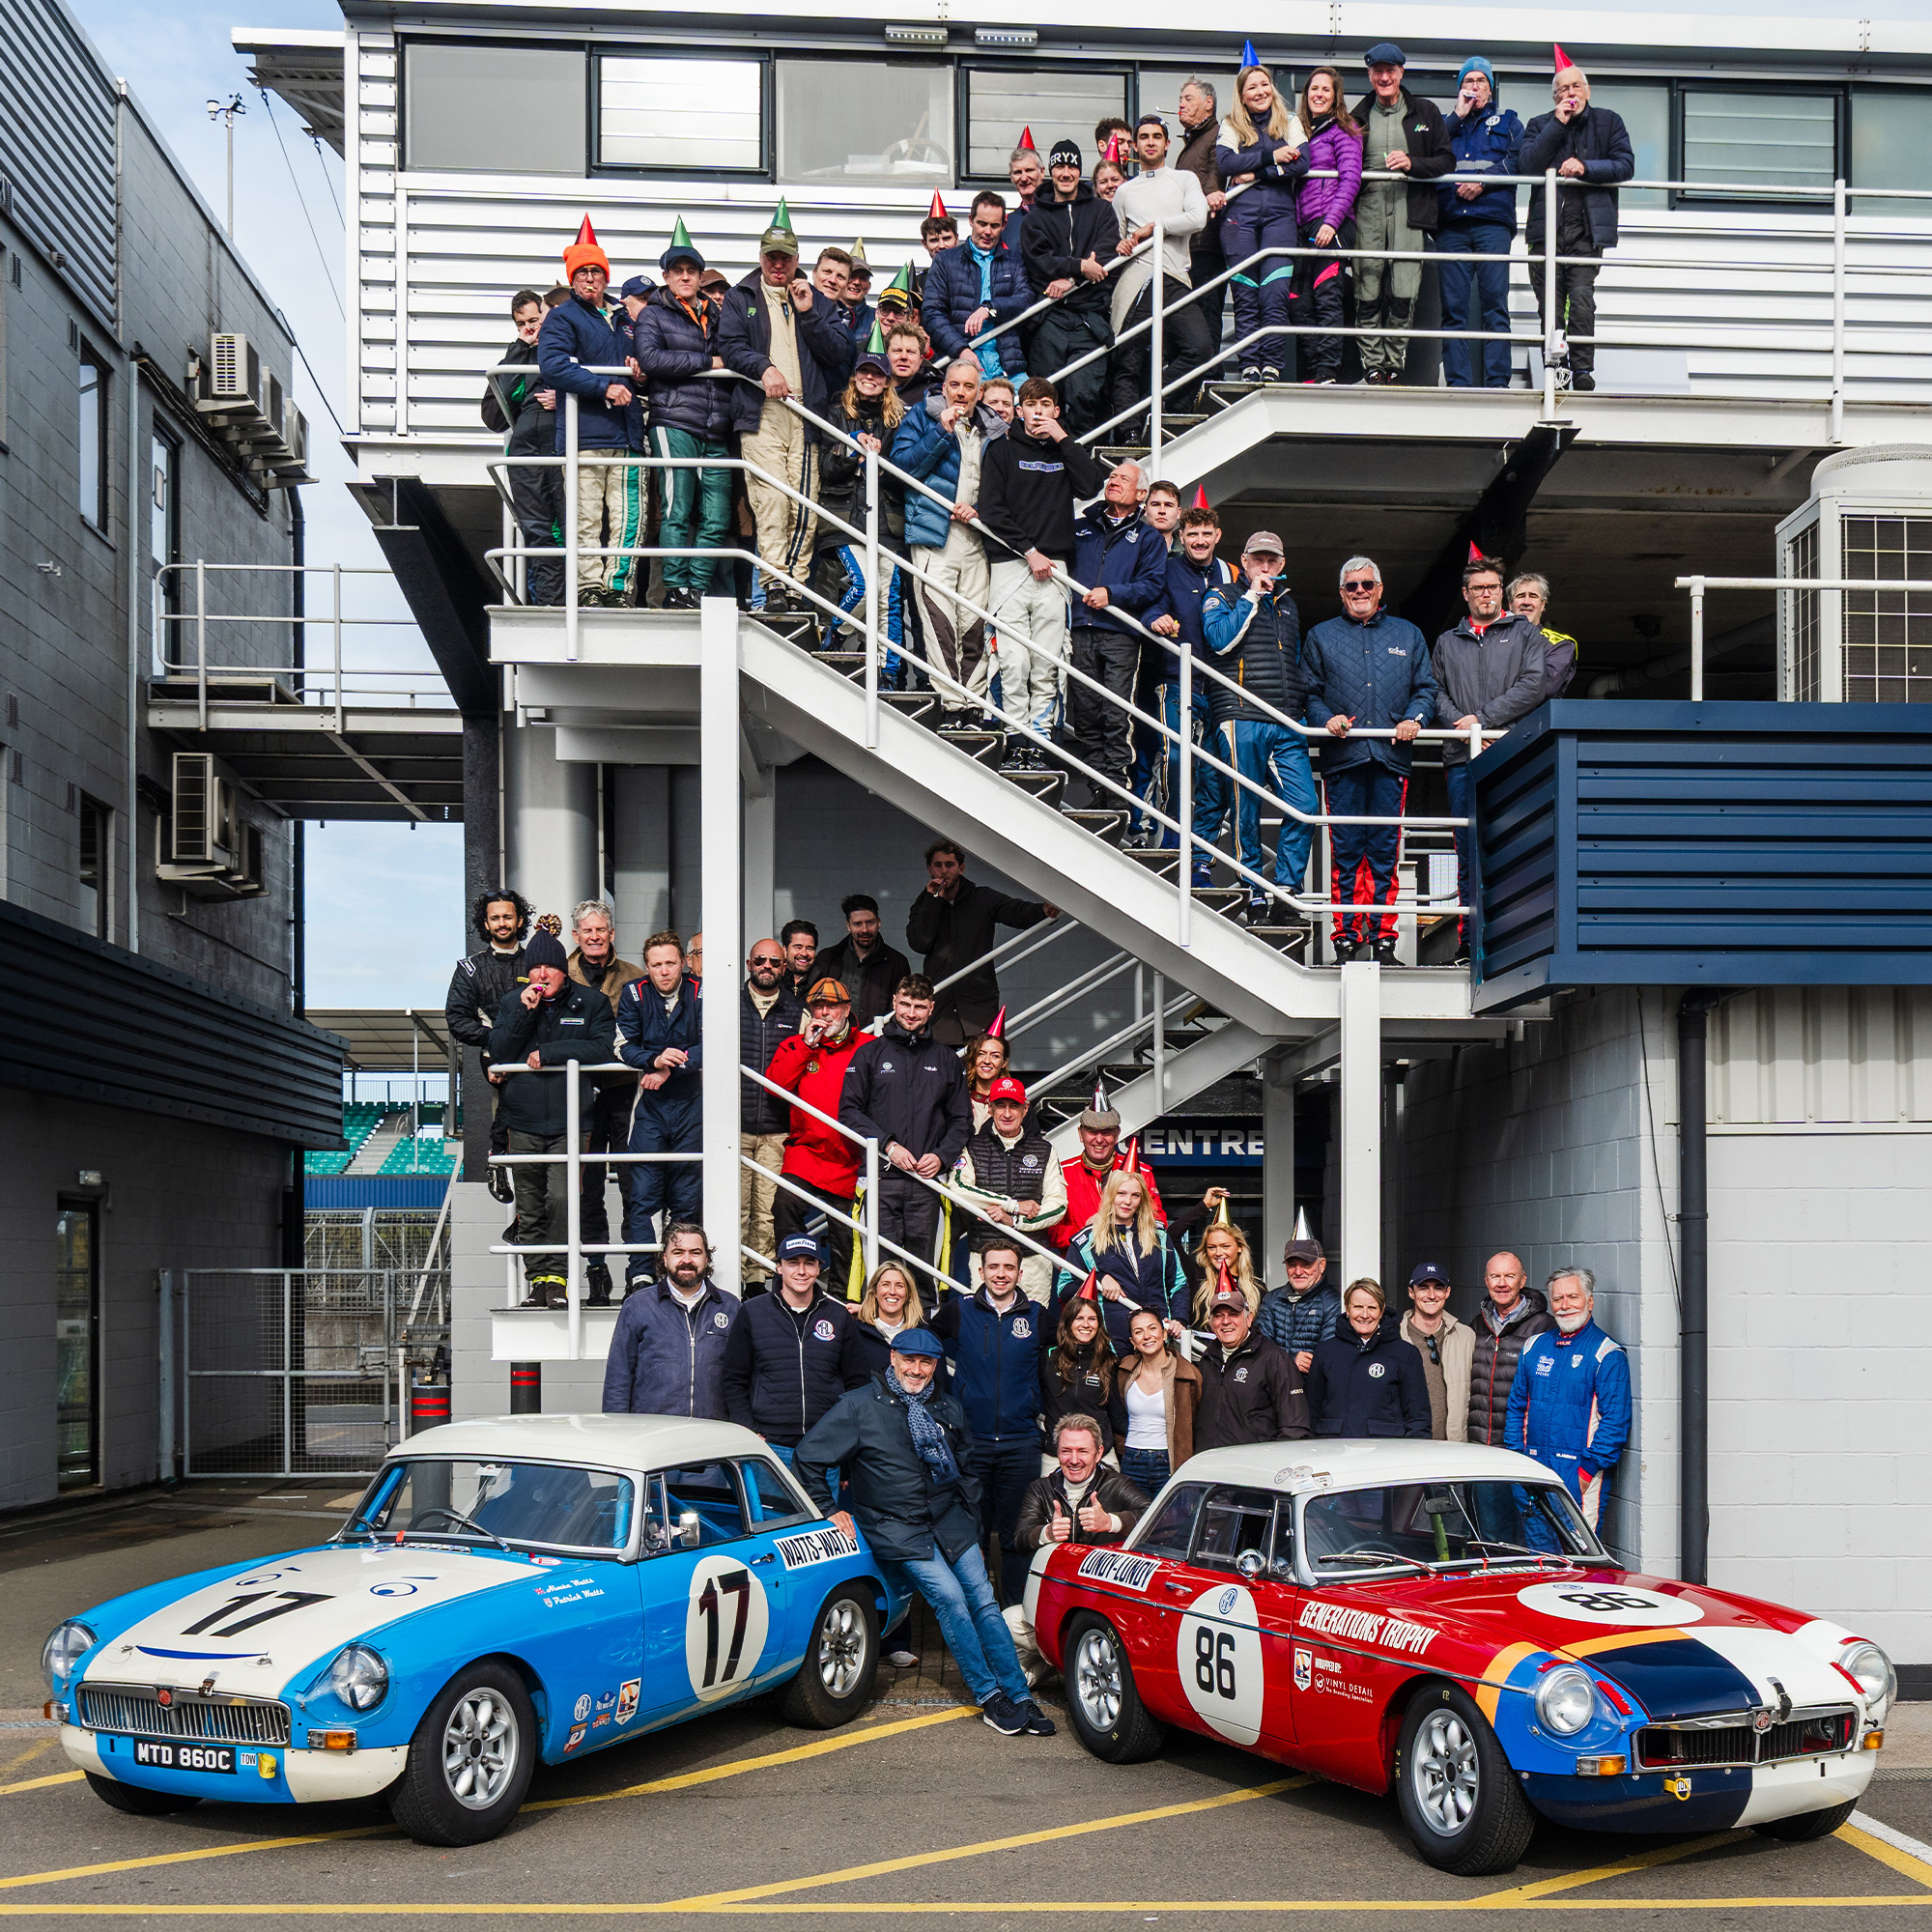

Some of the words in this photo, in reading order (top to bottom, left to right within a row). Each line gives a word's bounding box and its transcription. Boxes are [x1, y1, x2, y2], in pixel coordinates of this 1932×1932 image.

[1050, 152, 1078, 166] ERYX
[1080, 1549, 1159, 1588] LUNDY-LUNDY
[177, 1590, 337, 1637] 17
[1558, 1591, 1660, 1611] 86
[698, 1569, 751, 1689] 17
[1298, 1601, 1386, 1643] GENERATIONS
[1378, 1617, 1440, 1655] TROPHY
[1196, 1625, 1236, 1701] 86
[1325, 1677, 1347, 1690] VINYL
[1349, 1683, 1374, 1697] DETAIL
[137, 1743, 173, 1765] MTD
[179, 1747, 231, 1771] 860C
[242, 1753, 256, 1765] TOW
